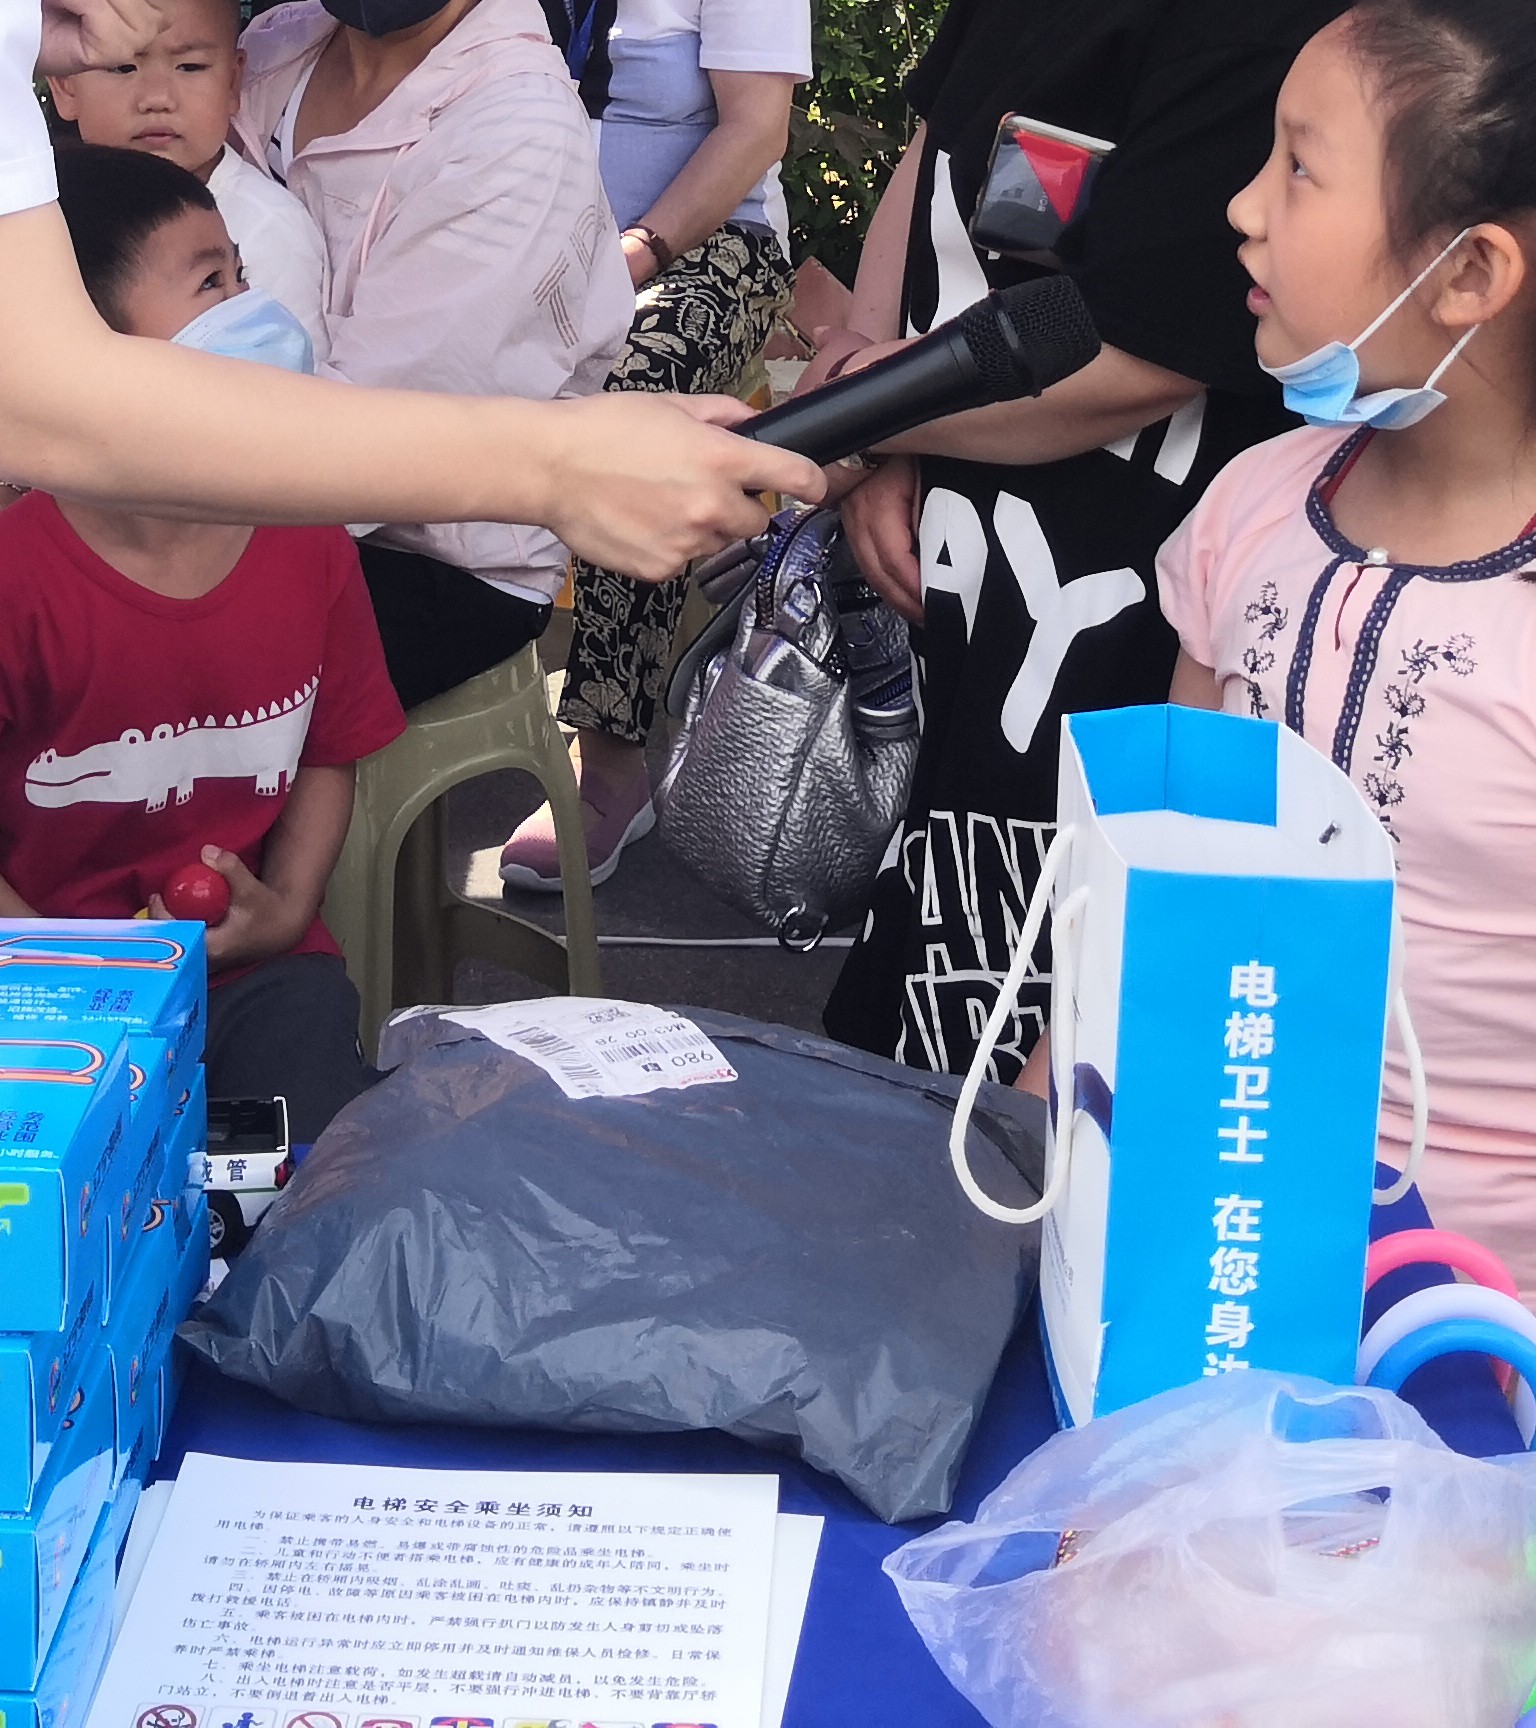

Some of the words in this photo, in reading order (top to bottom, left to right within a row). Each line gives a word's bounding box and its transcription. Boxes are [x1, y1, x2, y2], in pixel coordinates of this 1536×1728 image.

[1216, 959, 1279, 1164] 电梯卫士
[353, 1496, 593, 1518] 电梯安全乘坐须知
